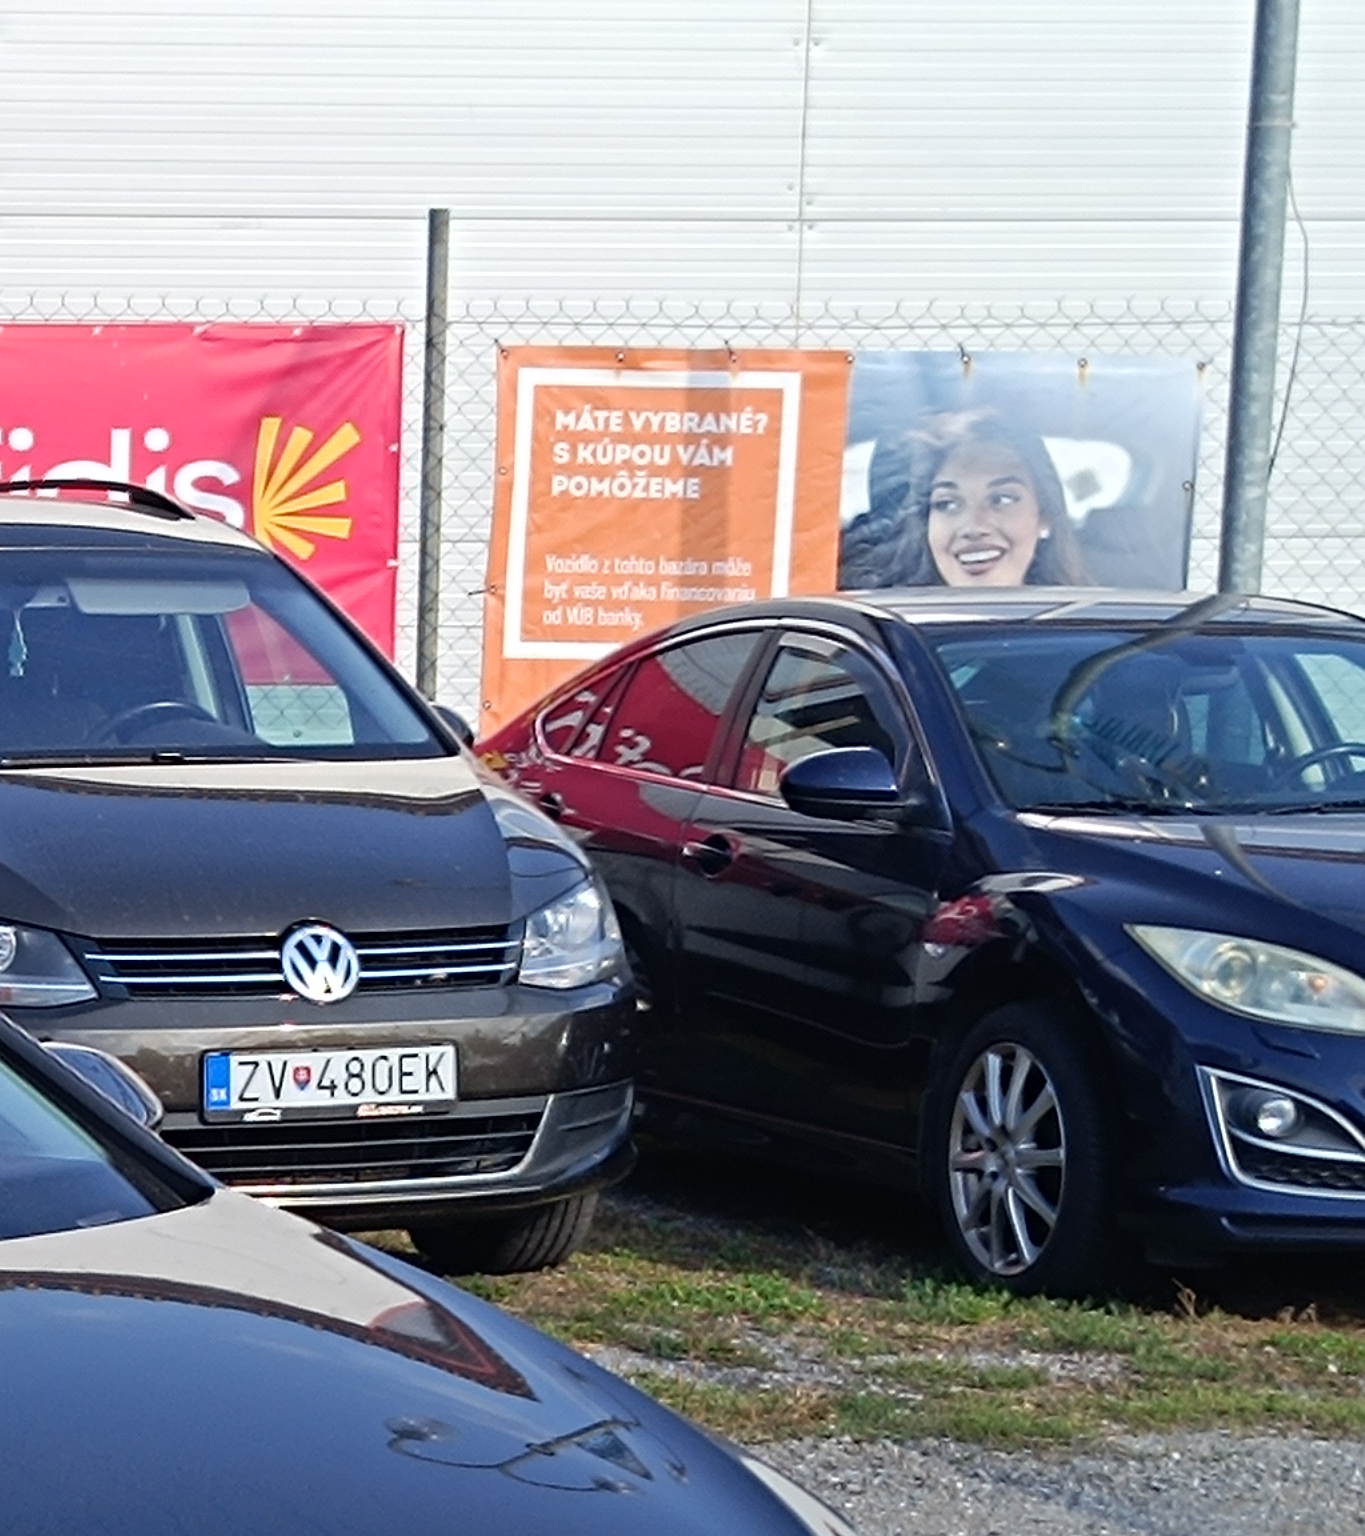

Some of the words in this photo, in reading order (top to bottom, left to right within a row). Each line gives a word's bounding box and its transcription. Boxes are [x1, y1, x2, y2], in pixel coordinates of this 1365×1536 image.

[555, 404, 623, 432] MÁTE
[629, 406, 768, 434] VYBRANÉ?
[553, 442, 570, 464] S
[577, 437, 670, 466] KÚPOU
[677, 438, 734, 467] VÁM
[551, 470, 701, 498] POMÔŽEME
[545, 554, 598, 574] Vozidlo
[603, 560, 611, 574] z
[614, 555, 655, 575] tohto
[543, 606, 562, 625] od
[237, 1059, 287, 1102] ZV
[316, 1052, 447, 1098] 480EK
